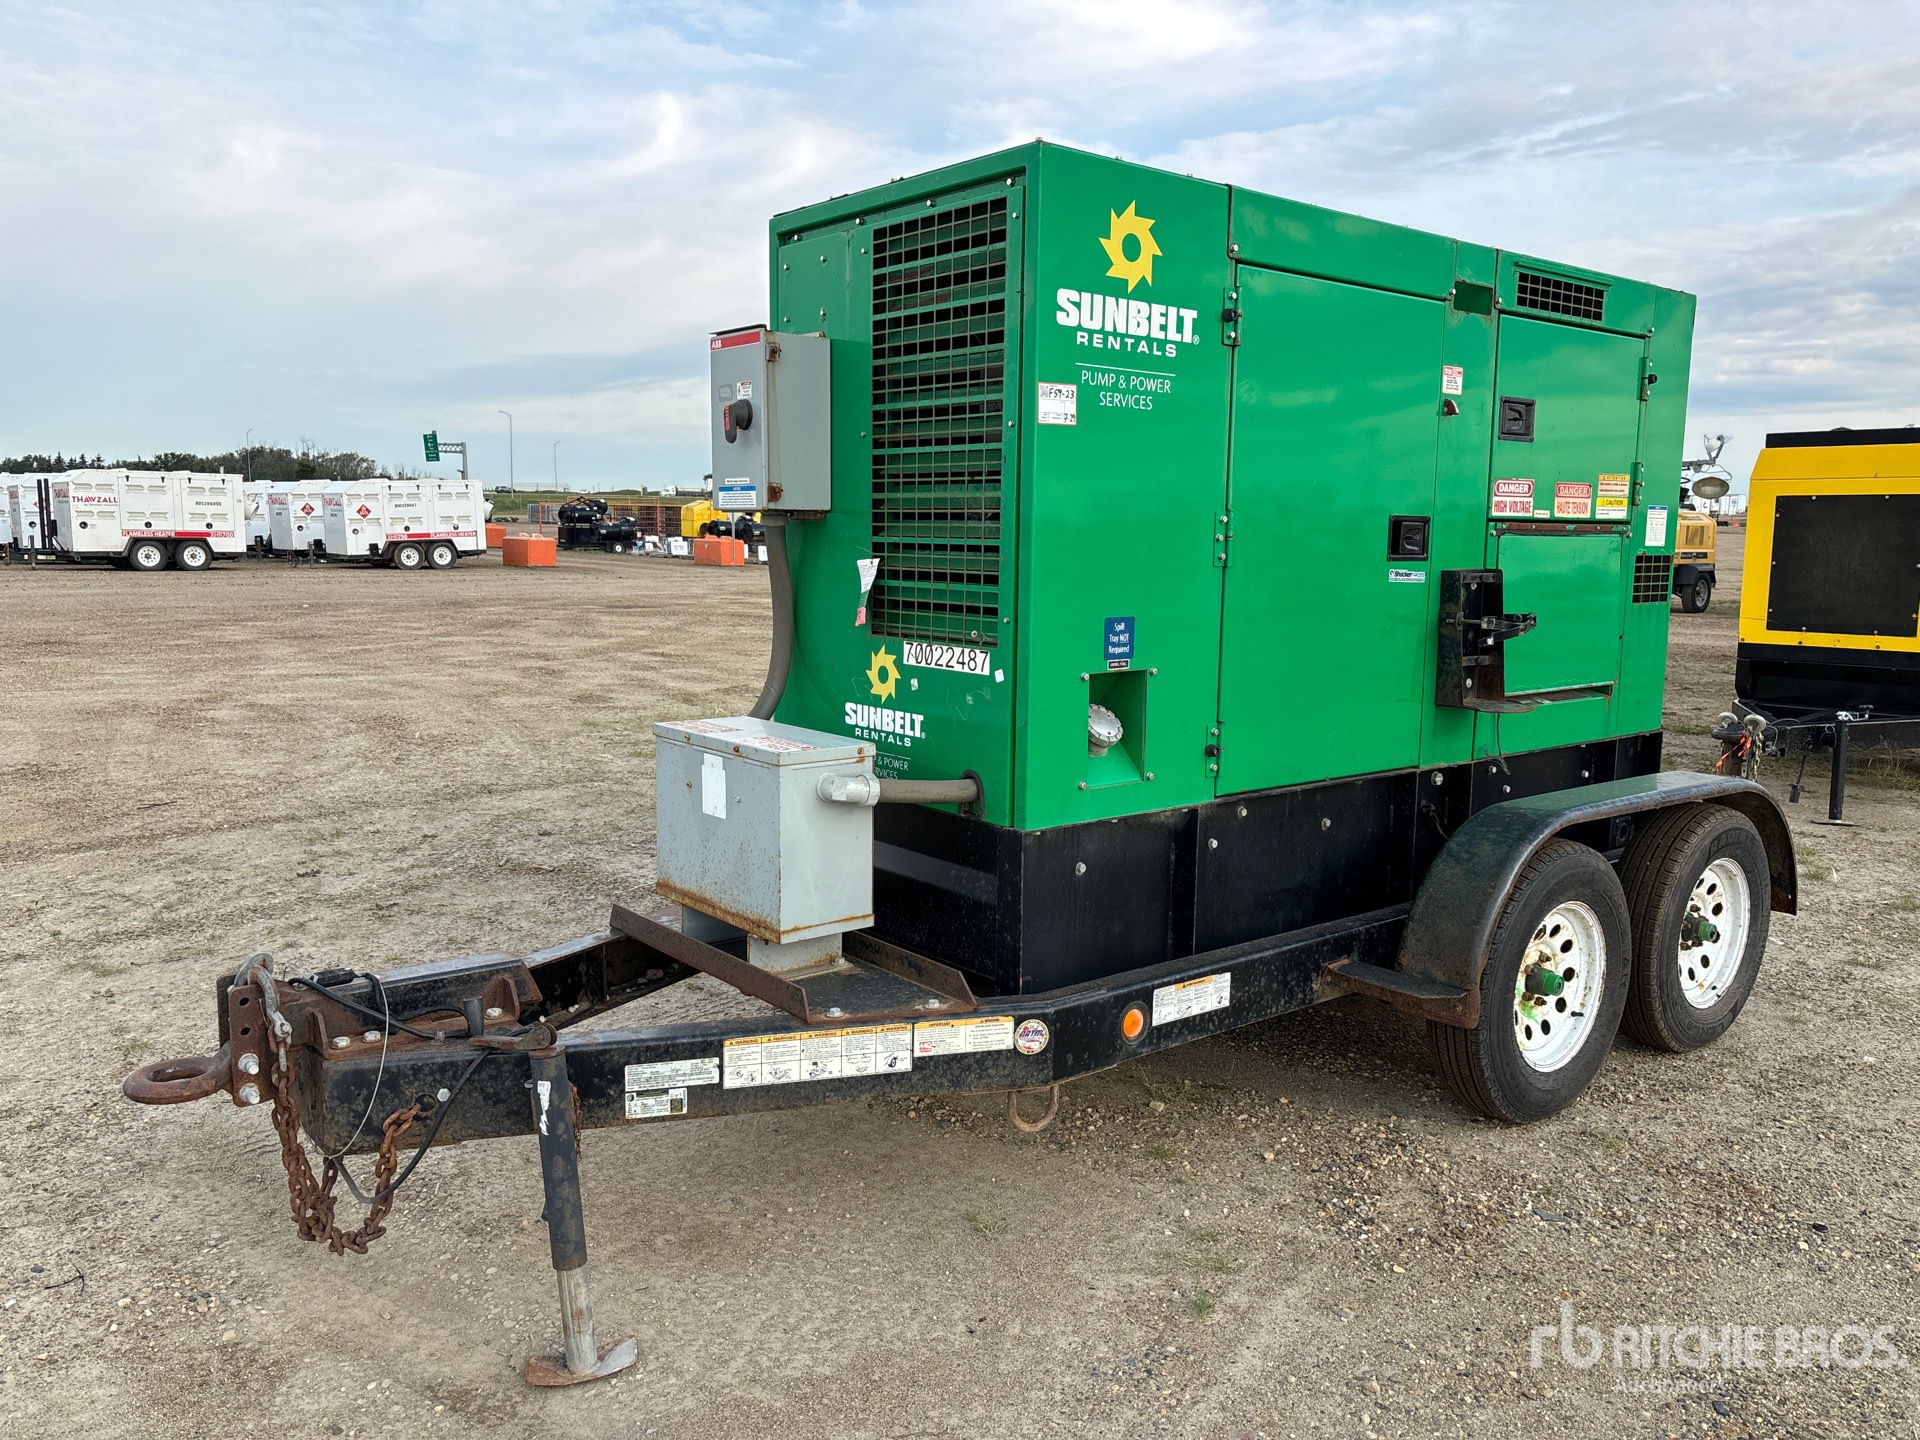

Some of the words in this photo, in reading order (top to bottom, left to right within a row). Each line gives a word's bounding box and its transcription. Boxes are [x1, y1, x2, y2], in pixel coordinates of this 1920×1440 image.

[1076, 331, 1177, 358] RENTALS
[1081, 370, 1116, 387] PUMP
[1118, 375, 1127, 389] &
[1130, 376, 1171, 394] POWER
[1099, 391, 1153, 411] SERVICES
[1499, 482, 1529, 494] DANGER
[1559, 486, 1588, 496] DANGER
[71, 496, 119, 504] THAWZALL
[1493, 500, 1507, 513] HIGH
[1509, 500, 1532, 514] VOLTAGE
[1556, 501, 1571, 514] HAUTE
[1571, 501, 1588, 515] TENSION
[1114, 622, 1125, 632] Spill
[1109, 634, 1119, 644] Tray
[1119, 633, 1130, 643] NOT
[1108, 645, 1130, 655] Required
[905, 642, 989, 673] 70022487
[855, 727, 912, 747] RENTALS
[877, 755, 883, 766] &
[883, 757, 909, 771] POWER
